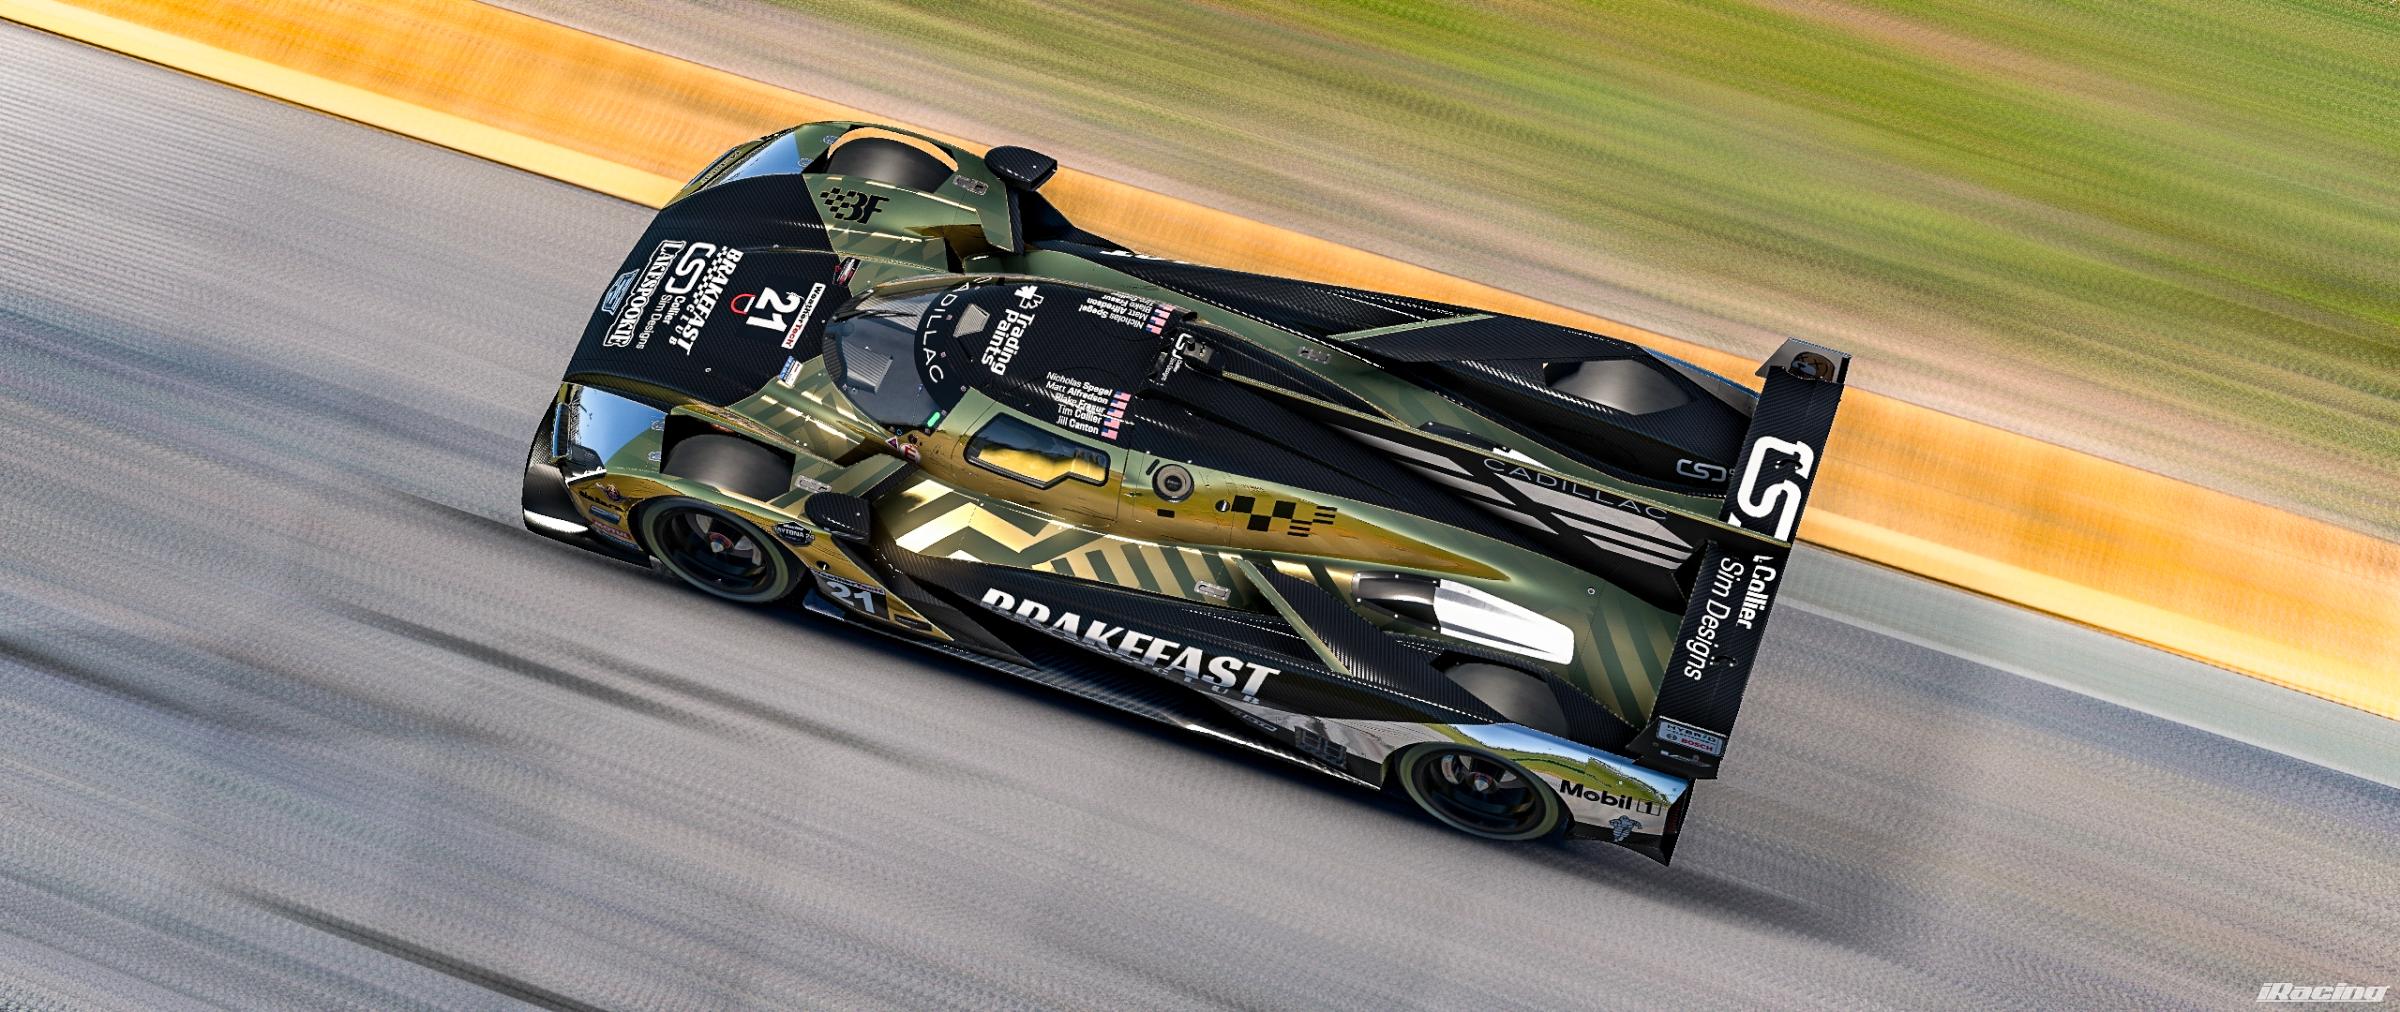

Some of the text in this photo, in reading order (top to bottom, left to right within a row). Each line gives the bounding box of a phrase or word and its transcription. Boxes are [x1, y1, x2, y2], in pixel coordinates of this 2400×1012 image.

[606, 241, 684, 346] LAKESPOOKIE
[663, 296, 686, 325] Collier
[677, 249, 744, 355] BRAKEFAST
[746, 286, 802, 332] 21
[1086, 297, 1149, 321] Matt Alfredson
[1129, 302, 1153, 314] Blake
[636, 294, 672, 349] Sim Designs
[669, 304, 696, 345] CLUB
[785, 285, 823, 348] WeatherTech
[923, 277, 992, 383] CADILLAC
[981, 308, 1020, 366] Paints
[1109, 315, 1145, 330] Nicholas
[991, 313, 1035, 375] Trading
[1045, 380, 1109, 404] Matt Alfredson
[1046, 371, 1114, 397] Nicholas Spegel
[1056, 415, 1099, 435] Jill Canton
[1057, 403, 1103, 424] Tim Collier
[1483, 458, 1668, 520] CADILLAC
[826, 580, 875, 614] 21
[1736, 565, 1776, 630] Collier
[1684, 557, 1744, 681] Sim Designs
[1680, 737, 1713, 751] BOSCH
[1560, 779, 1633, 810] Mobil
